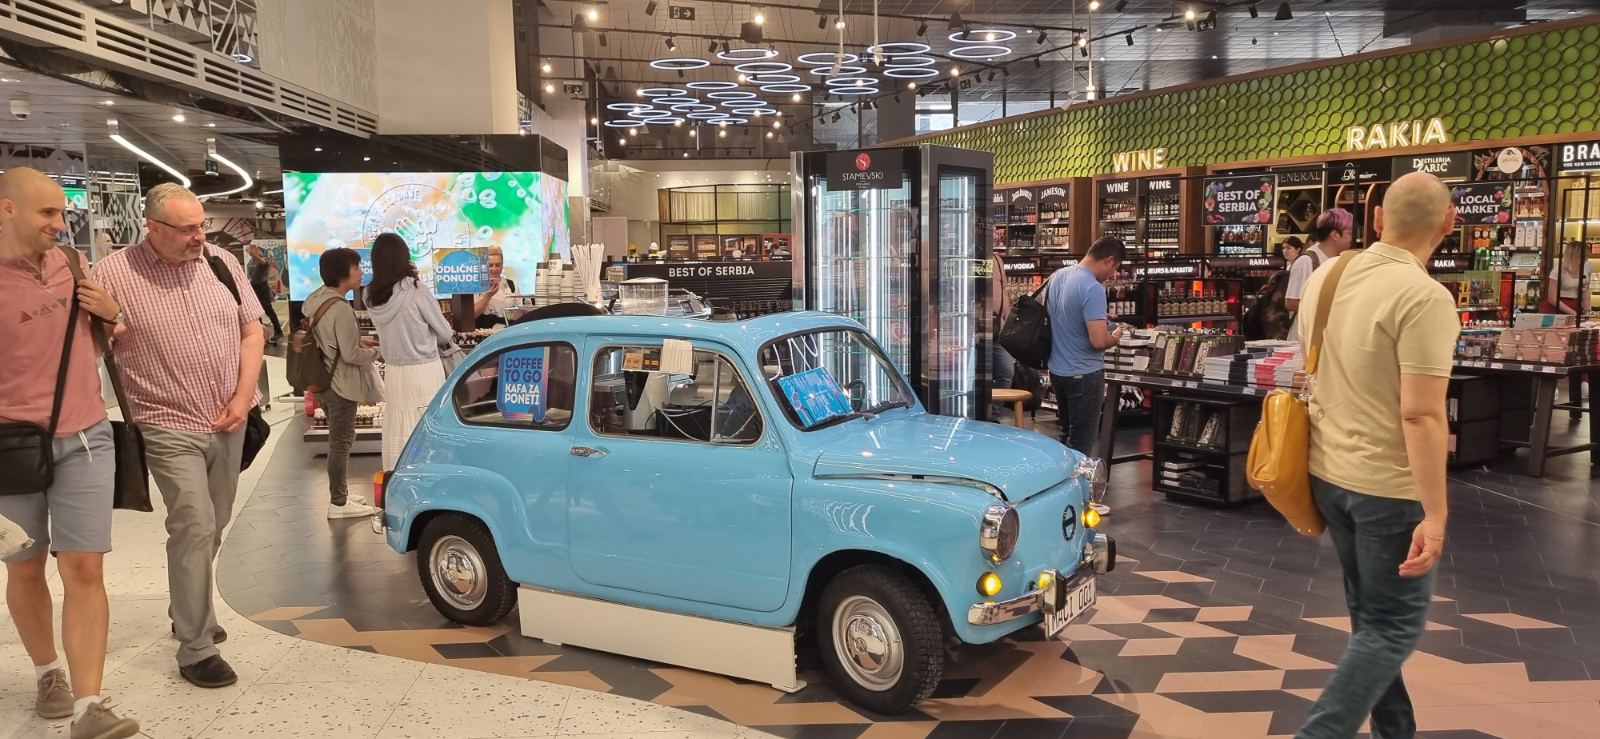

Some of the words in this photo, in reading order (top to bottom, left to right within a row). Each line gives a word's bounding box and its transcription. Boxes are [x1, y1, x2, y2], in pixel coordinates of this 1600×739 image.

[1346, 117, 1448, 151] RAKIA
[1112, 147, 1167, 173] WINE
[842, 171, 884, 181] STAMEVSKI
[1280, 171, 1321, 183] ENERAL
[1106, 181, 1129, 193] WINE
[1040, 186, 1067, 200] JAMESON
[1217, 190, 1243, 201] BEST
[1245, 190, 1261, 200] OF
[1460, 194, 1496, 204] LOCAL
[1218, 201, 1257, 212] SERBIA
[1456, 204, 1500, 214] MARKET
[1003, 262, 1035, 270] IN/VODKA
[1249, 258, 1270, 266] RAKIA
[1434, 259, 1455, 268] RAKIA
[436, 263, 479, 274] ODLIČNE
[668, 267, 695, 277] BEST
[698, 266, 713, 276] OF
[715, 265, 755, 276] SERBIA
[436, 273, 479, 283] PONUDE
[505, 357, 543, 369] COFFEE
[504, 369, 520, 382] TO
[523, 369, 542, 383] GO
[505, 383, 527, 393] KAFA
[528, 384, 540, 394] ZA
[504, 393, 540, 405] PONETI
